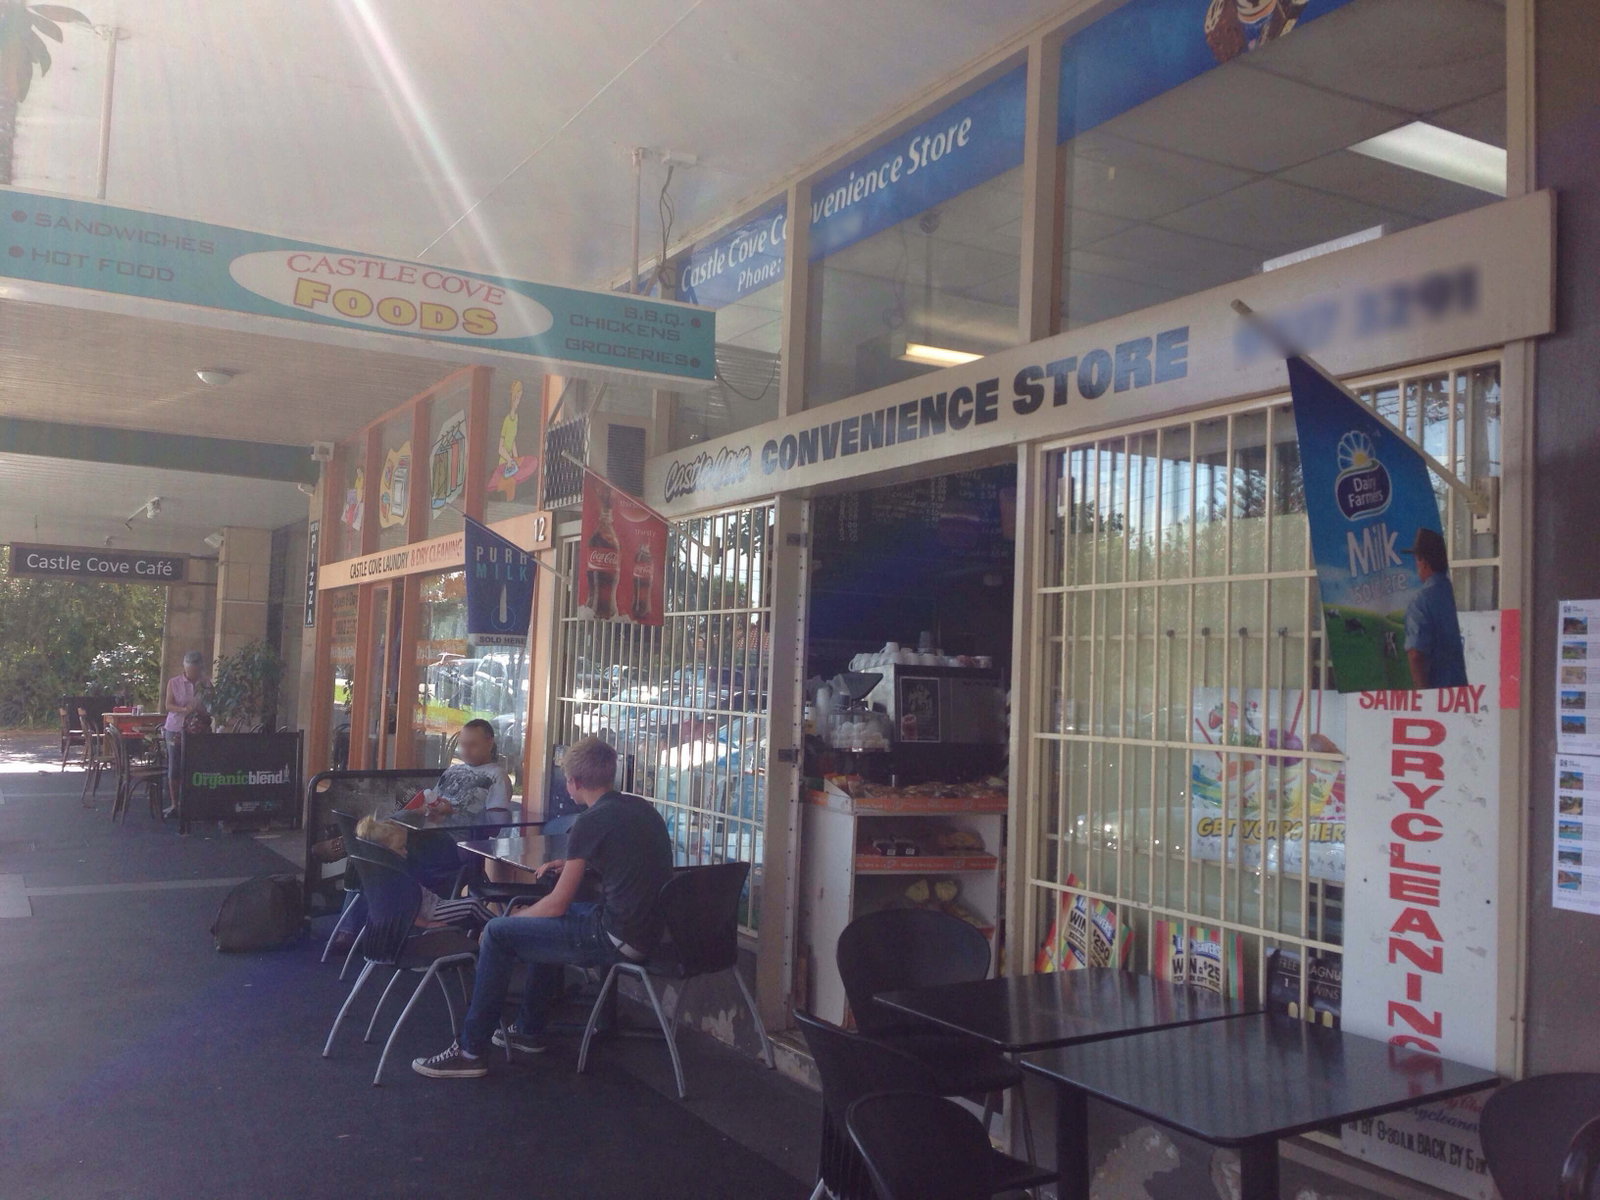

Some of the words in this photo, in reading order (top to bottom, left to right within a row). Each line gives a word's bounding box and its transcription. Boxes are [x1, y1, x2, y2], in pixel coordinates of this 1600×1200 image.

[681, 248, 726, 293] Castle
[728, 230, 768, 268] Cove
[907, 116, 972, 176] Store
[34, 212, 216, 256] SANDWICHES
[31, 248, 90, 271] HOT
[98, 257, 175, 283] FOOD
[287, 253, 417, 284] CASTLE
[421, 271, 507, 306] COVE
[737, 258, 782, 294] Phone:
[293, 276, 499, 336] FOODS
[569, 313, 681, 342] CHICKENS
[565, 337, 689, 367] GROCERIES
[664, 451, 714, 504] Castle
[761, 377, 999, 476] CONVENIENCE
[1012, 326, 1190, 416] STORE
[533, 514, 547, 544] 12
[26, 553, 82, 572] Castle
[86, 557, 130, 576] Cove
[134, 559, 173, 577] Café
[350, 560, 367, 580] CASTLE
[368, 557, 382, 576] COVE
[382, 551, 410, 574] LAUNDRY
[417, 546, 430, 566] DRY
[1346, 522, 1404, 578] Milk
[306, 534, 318, 624] PIZZA
[475, 562, 529, 583] MILK
[479, 636, 503, 645] SOLD
[504, 636, 526, 645] HERE
[1359, 688, 1423, 713] SAME
[1437, 684, 1487, 715] DAY
[1197, 816, 1237, 838] GET
[1308, 821, 1346, 844] HER
[1172, 957, 1197, 975] WN
[1309, 965, 1342, 982] AGNU
[1417, 1132, 1447, 1163] BACK
